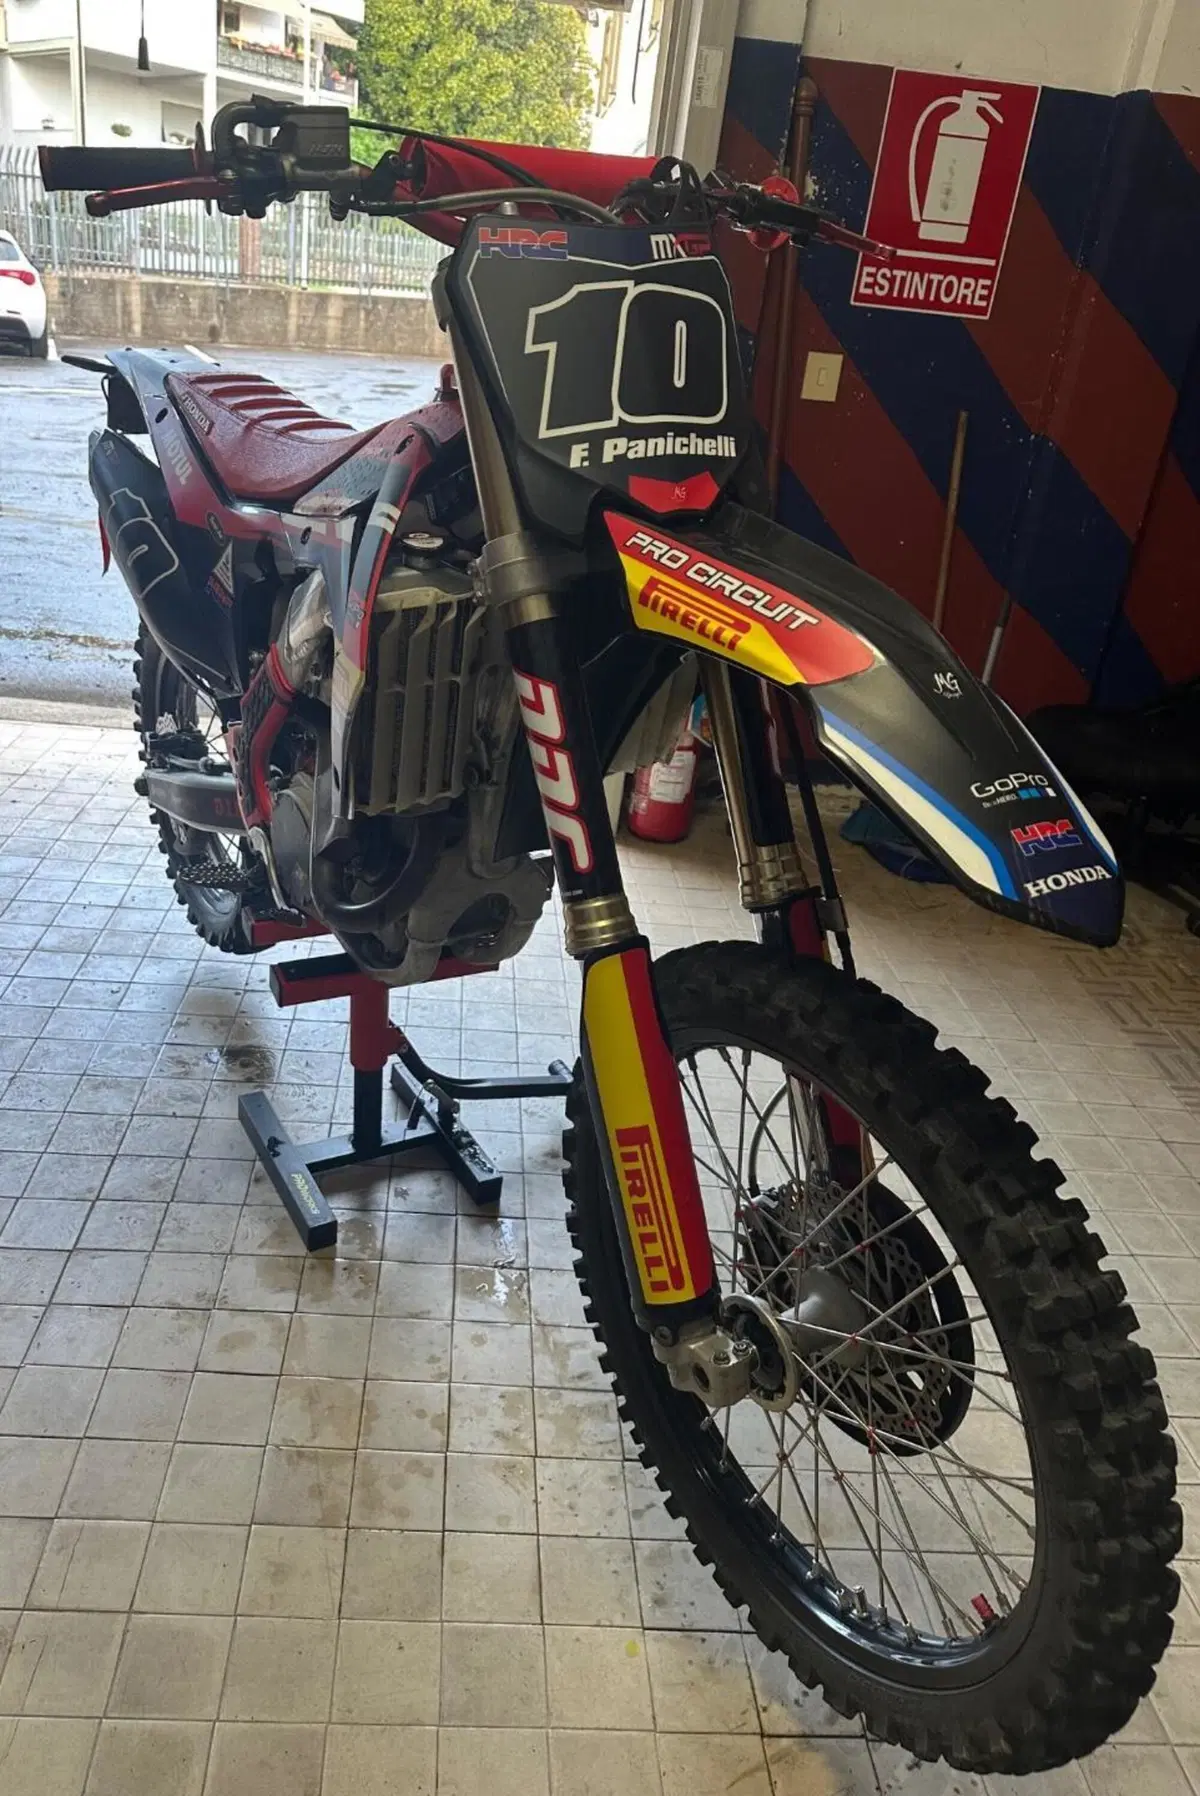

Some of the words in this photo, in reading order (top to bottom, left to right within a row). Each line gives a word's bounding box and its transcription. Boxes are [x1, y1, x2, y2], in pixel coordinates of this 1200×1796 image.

[479, 227, 568, 261] HRC
[858, 266, 992, 306] ESTINTORE
[525, 280, 728, 439] 10
[570, 442, 589, 468] F.
[602, 432, 737, 463] Panichelli
[625, 532, 690, 570] PRO
[686, 561, 819, 631] CIRCUIT
[638, 575, 752, 651] PIRELLI
[970, 772, 1049, 798] GoPro
[1010, 819, 1083, 857] HRC
[1024, 864, 1112, 898] HONDA
[615, 1124, 685, 1293] PIRELLI
